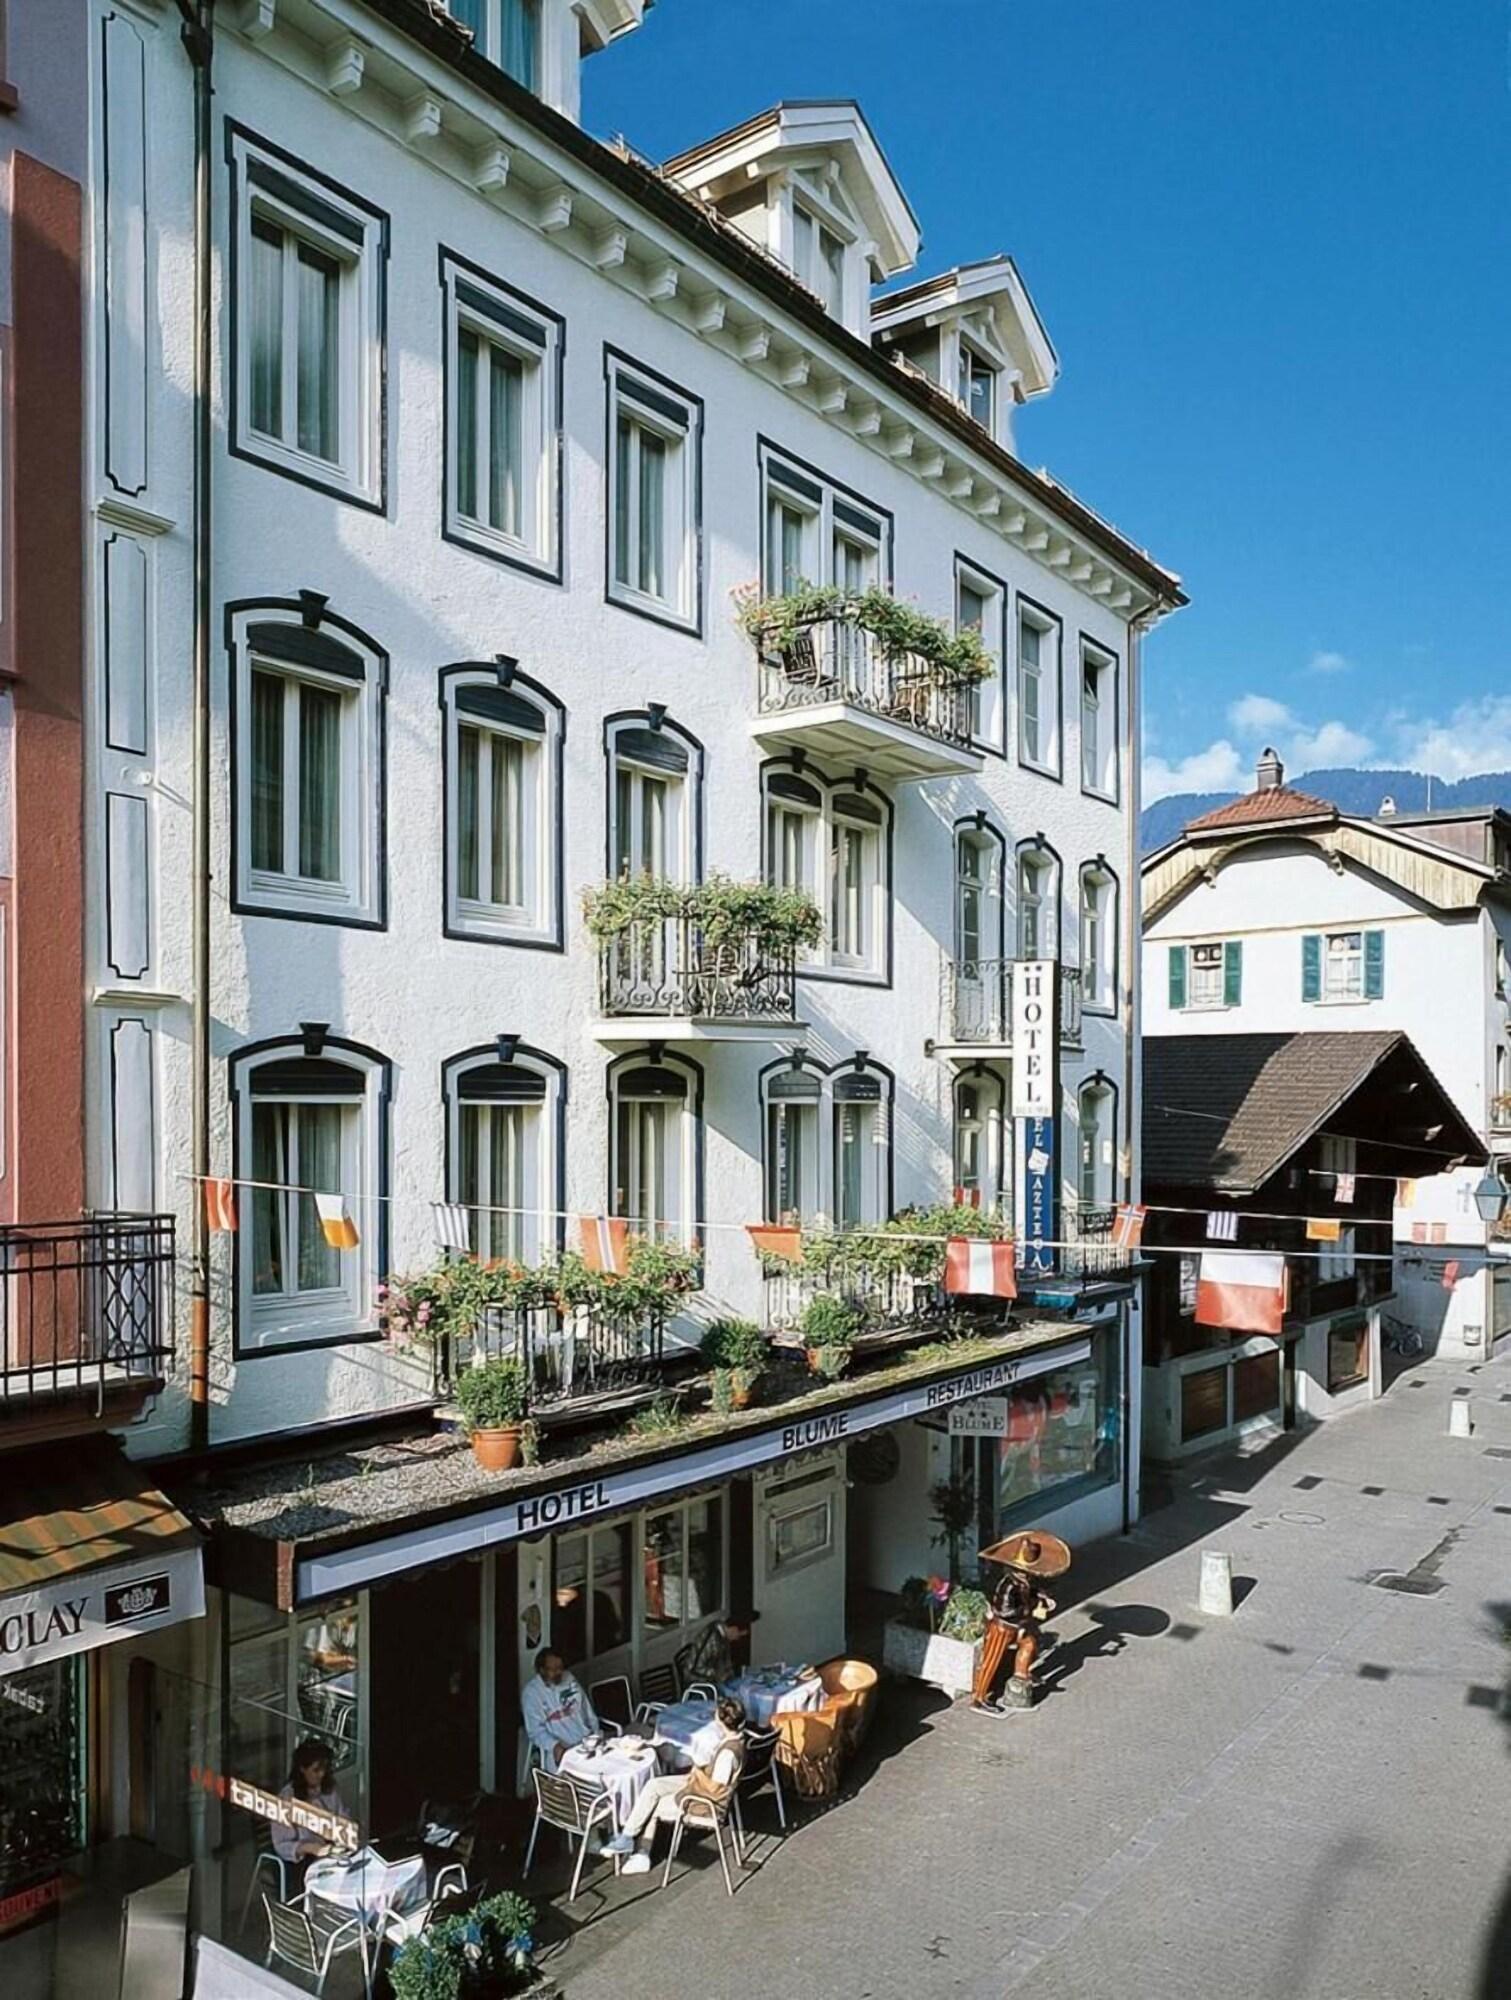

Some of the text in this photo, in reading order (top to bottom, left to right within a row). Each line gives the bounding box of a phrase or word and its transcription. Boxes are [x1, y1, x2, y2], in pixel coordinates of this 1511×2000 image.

[1024, 976, 1042, 1102] HOTEL
[518, 1362, 1021, 1531] HOTEL BLUME RESTAURANT
